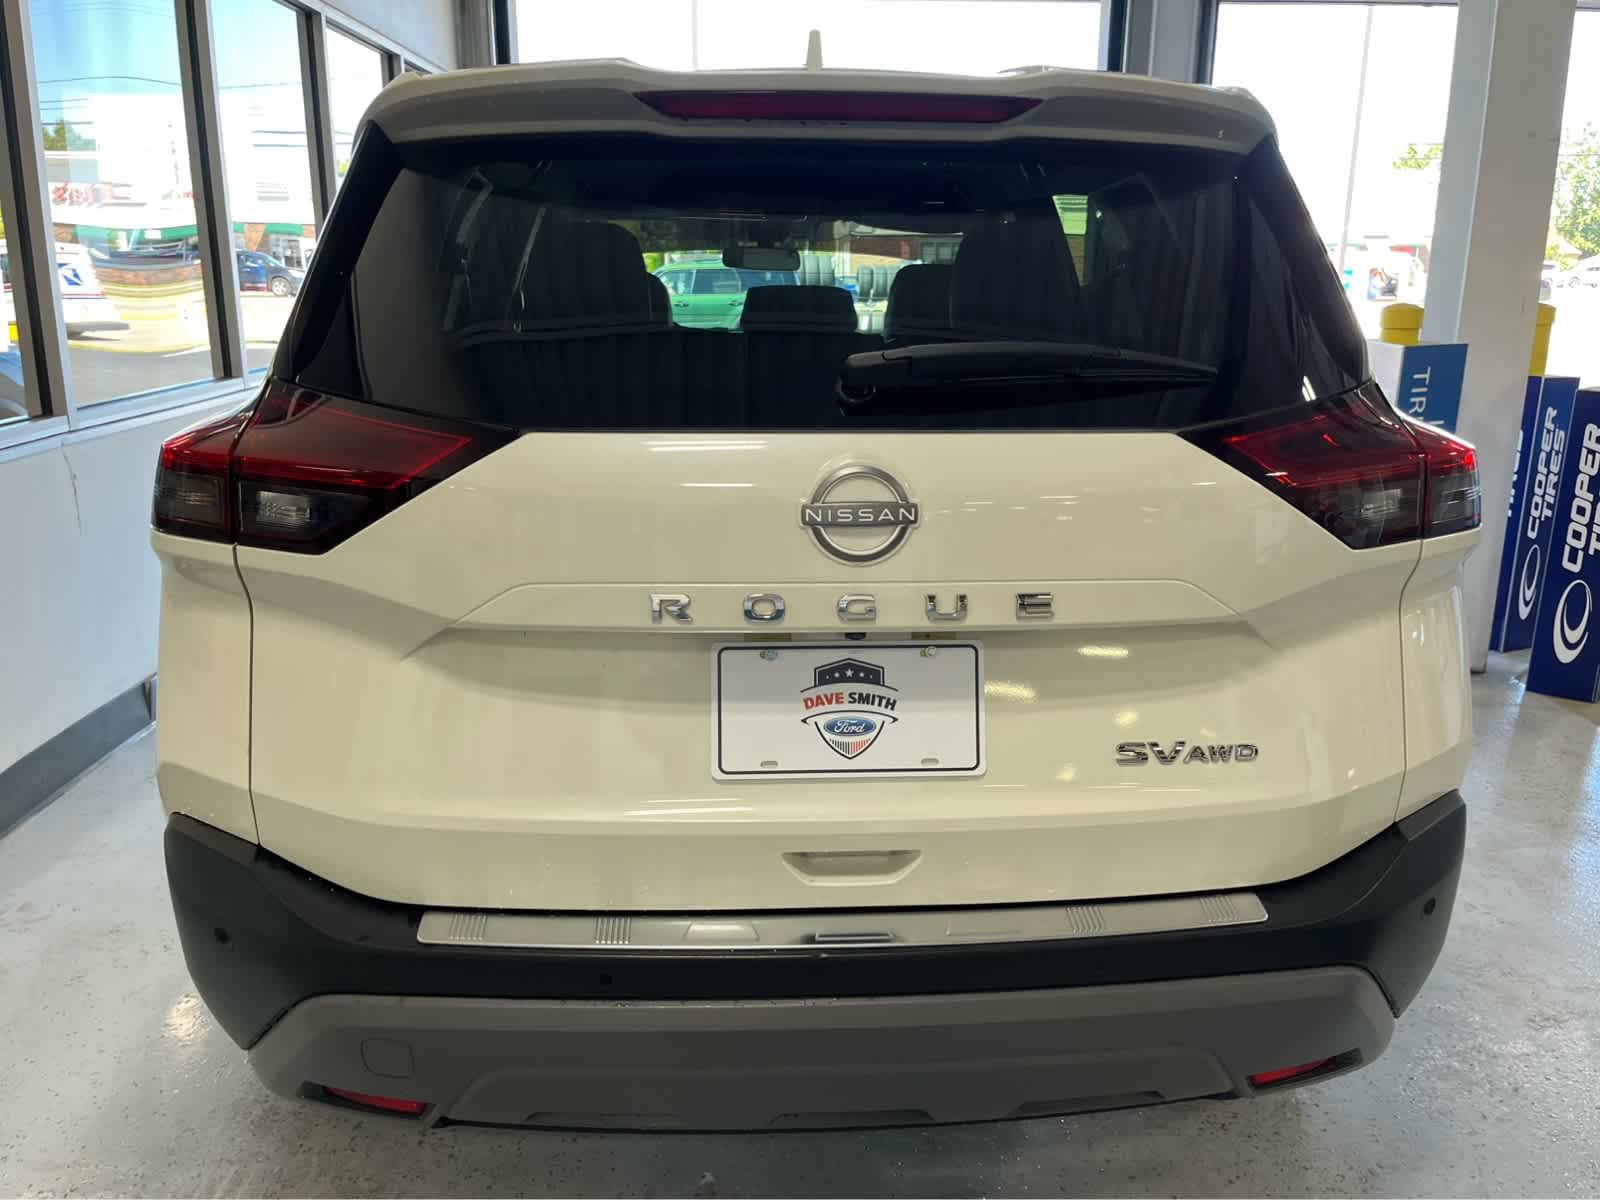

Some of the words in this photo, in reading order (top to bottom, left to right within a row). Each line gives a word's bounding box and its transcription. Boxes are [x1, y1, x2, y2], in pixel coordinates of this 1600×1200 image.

[1409, 366, 1431, 420] TIR
[1527, 406, 1558, 540] COOPER
[1541, 428, 1565, 521] TIRES
[1561, 423, 1600, 573] COOPER
[805, 508, 915, 522] NISSAN
[651, 592, 1054, 624] ROGUE
[803, 692, 844, 710] DAVE
[848, 692, 897, 710] SMITH
[834, 720, 866, 733] Ford
[1116, 741, 1186, 767] SV
[1183, 744, 1259, 764] AWD
